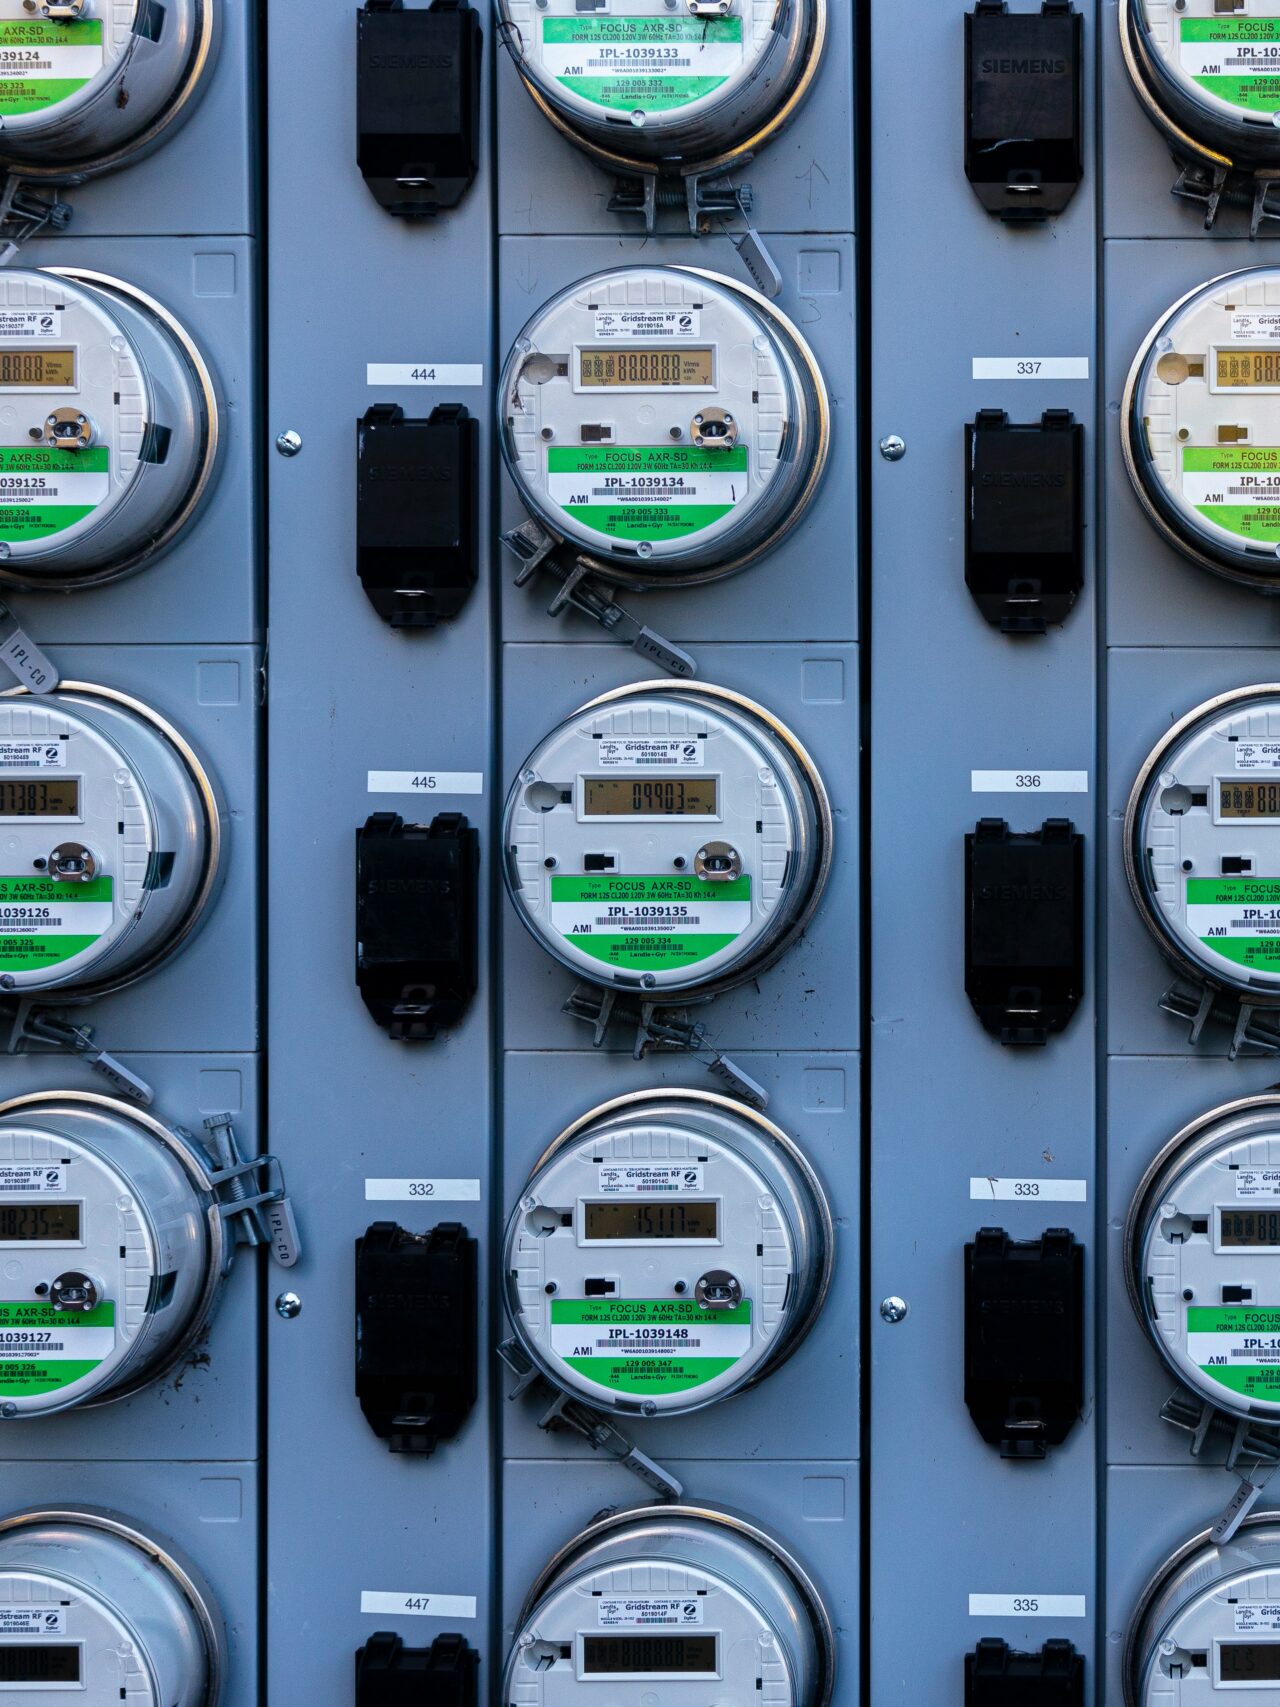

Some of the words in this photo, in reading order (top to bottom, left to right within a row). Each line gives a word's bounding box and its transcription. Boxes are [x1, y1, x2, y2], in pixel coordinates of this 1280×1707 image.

[4, 26, 44, 36] AXR-SD
[601, 25, 636, 33] FOCUS
[642, 25, 681, 33] AXR-SD
[1238, 23, 1274, 32] FOCUS
[600, 48, 678, 58] IPL-1039133
[564, 66, 584, 74] AMI
[982, 59, 1066, 74] SIEMENS
[1201, 65, 1221, 73] AMI
[1018, 362, 1041, 374] 337
[411, 369, 435, 380] 444
[10, 453, 50, 462] AXR-SD
[606, 453, 642, 462] FOCUS
[647, 452, 688, 461] AXR-SD
[1241, 452, 1277, 461] FOCUS
[605, 477, 684, 487] IPL-1039134
[569, 495, 589, 503] AMI
[1204, 494, 1224, 502] AMI
[643, 642, 686, 673] IPL-CO
[9, 644, 46, 686] IPL-CO
[412, 777, 436, 788] 445
[1016, 775, 1040, 787] 336
[14, 882, 54, 893] AXR-SD
[609, 882, 645, 891] FOCUS
[651, 882, 692, 891] AXR-SD
[1244, 884, 1280, 893] FOCUS
[608, 906, 687, 916] IPL-1039135
[572, 924, 592, 932] AMI
[1207, 927, 1227, 935] AMI
[409, 1184, 434, 1195] 332
[1015, 1184, 1039, 1195] 333
[271, 1213, 290, 1260] IPL-CO
[16, 1307, 56, 1317] AXR-SD
[610, 1304, 646, 1313] FOCUS
[652, 1304, 693, 1313] AXR-SD
[1245, 1314, 1280, 1323] FOCUS
[608, 1329, 688, 1339] IPL-1039148
[573, 1347, 593, 1355] AMI
[1208, 1356, 1228, 1364] AMI
[405, 1599, 429, 1610] 447
[1014, 1599, 1038, 1611] 335
